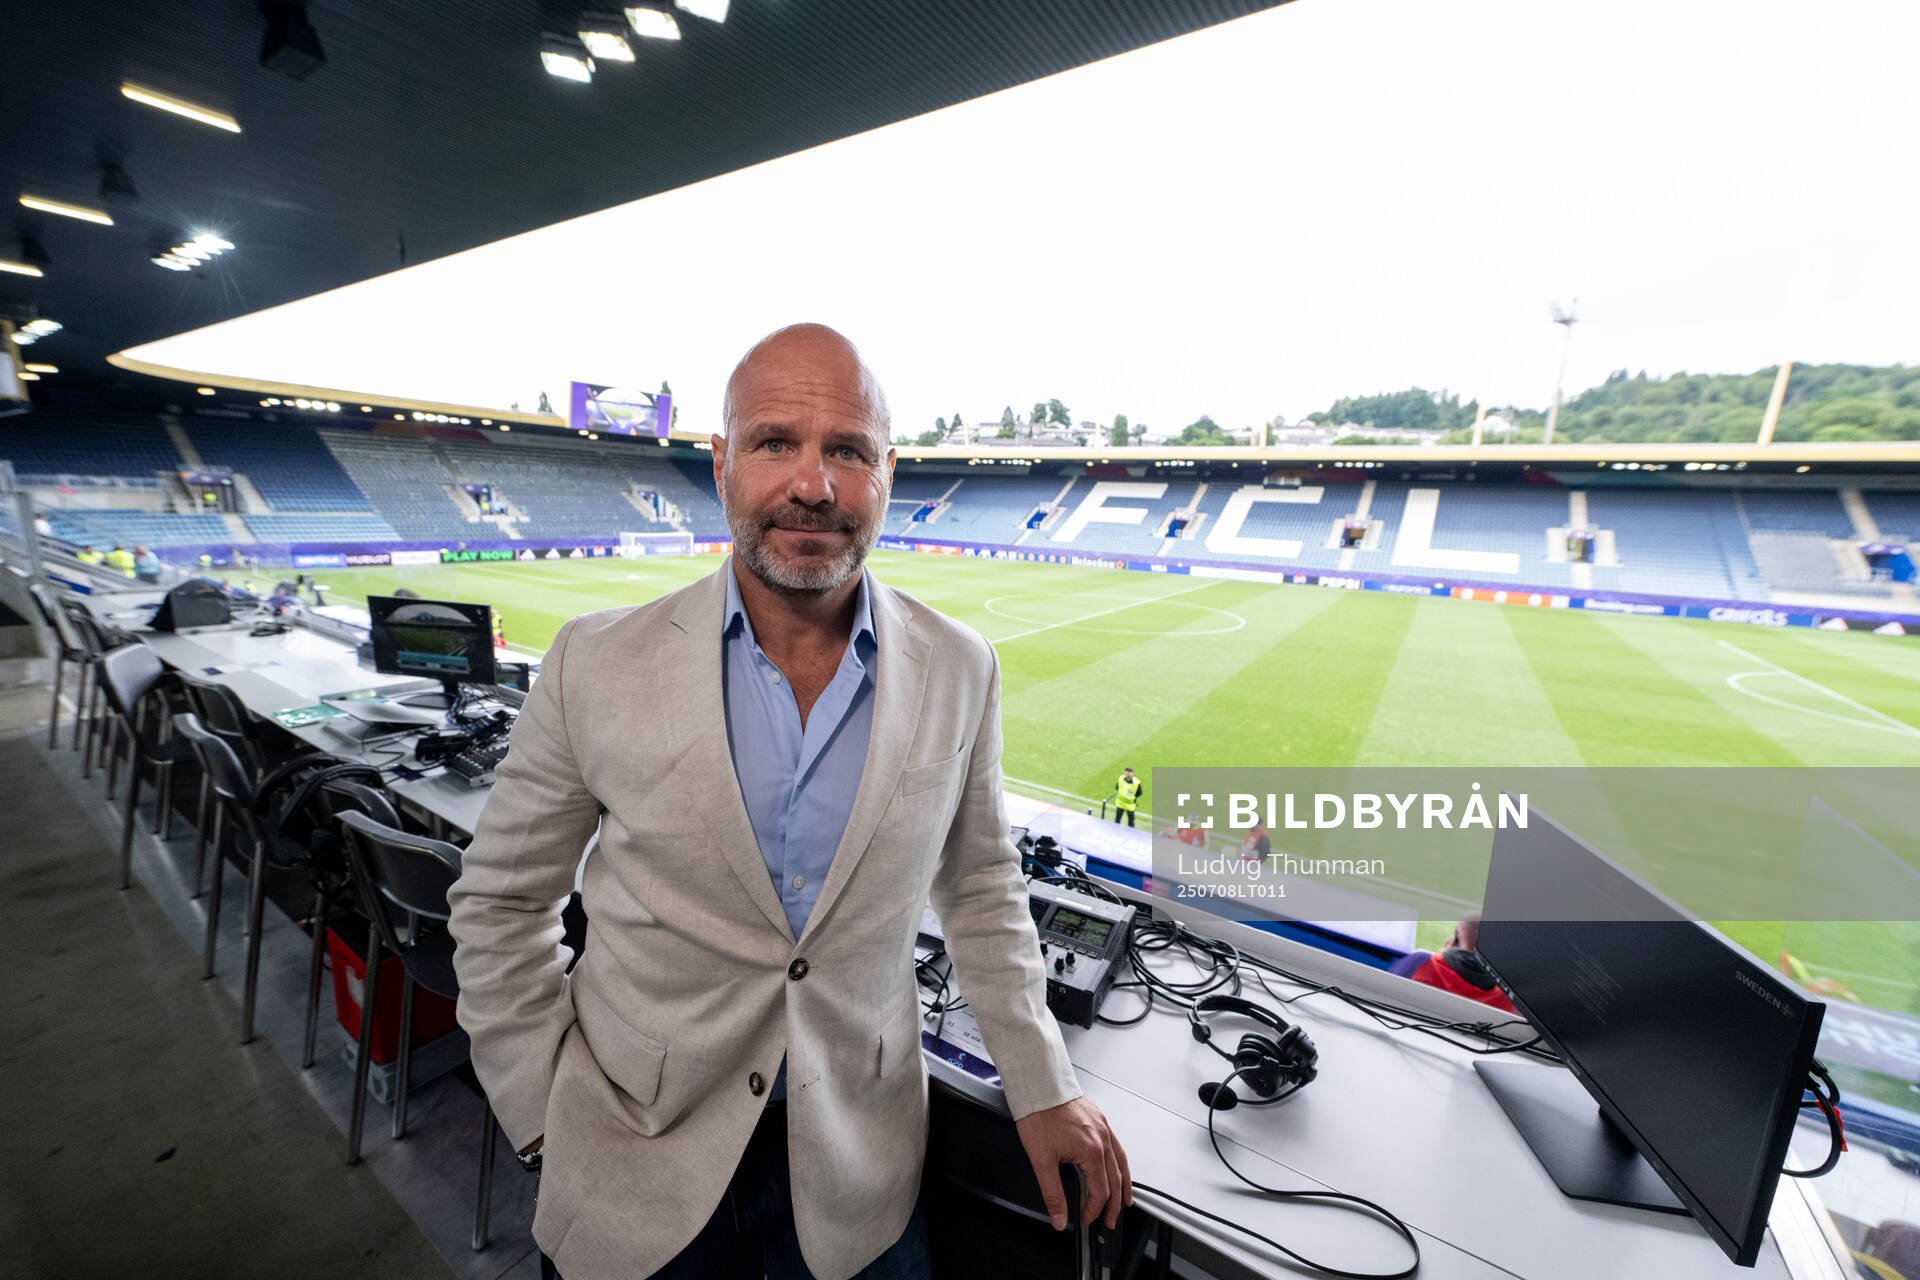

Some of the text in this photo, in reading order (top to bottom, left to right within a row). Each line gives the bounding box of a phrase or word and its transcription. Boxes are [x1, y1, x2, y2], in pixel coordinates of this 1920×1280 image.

[442, 549, 514, 562] PLAY NOW
[1735, 970, 1782, 1009] SWEDEN
